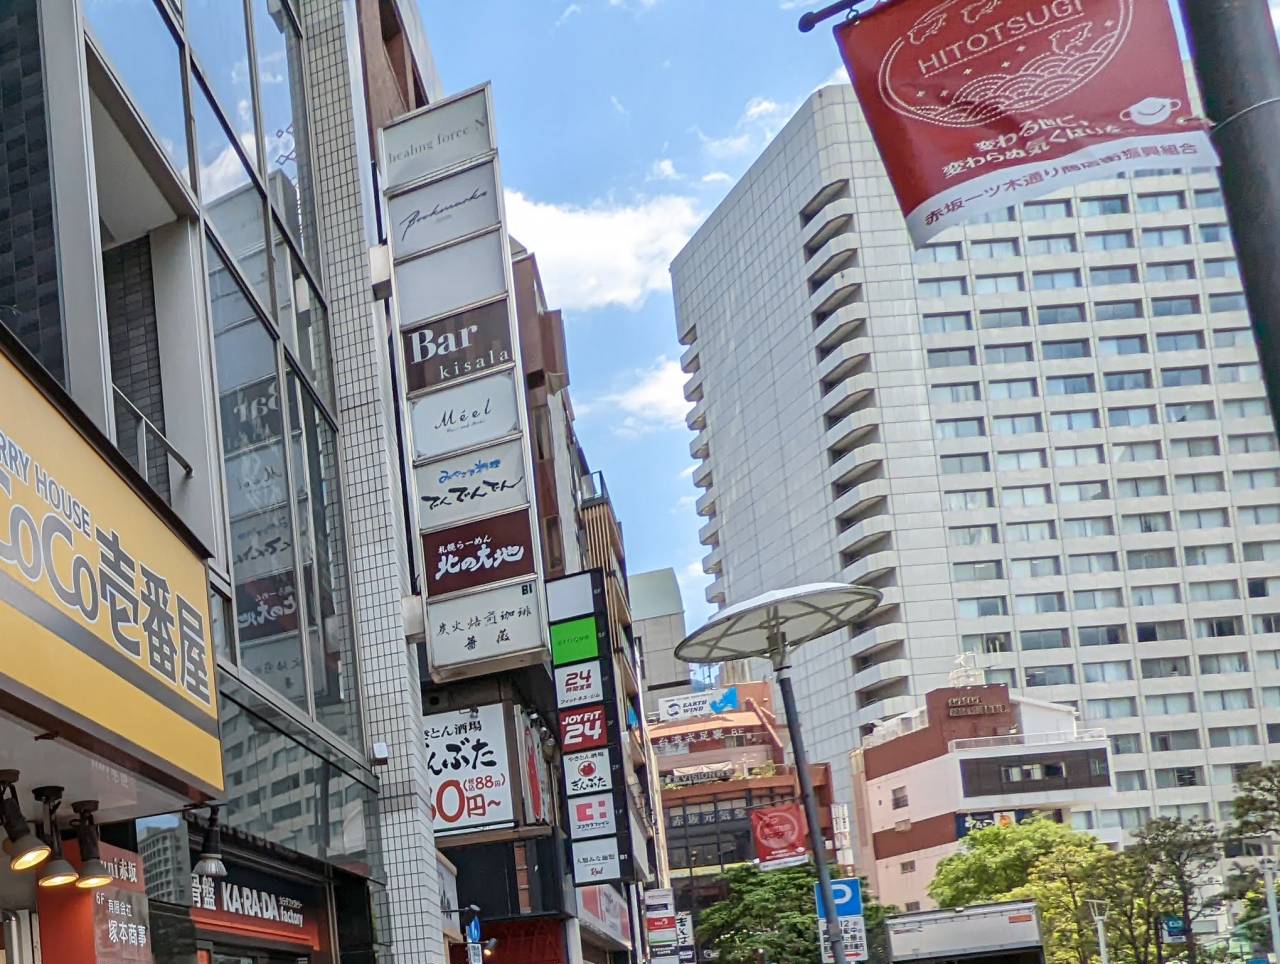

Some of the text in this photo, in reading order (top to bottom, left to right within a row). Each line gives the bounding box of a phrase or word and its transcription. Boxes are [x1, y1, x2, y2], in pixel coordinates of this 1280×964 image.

[388, 140, 433, 165] healing
[437, 126, 469, 145] force
[408, 324, 478, 364] Bar
[440, 350, 509, 379] kisala
[435, 398, 492, 430] Méel
[34, 464, 91, 539] HOUSE
[438, 535, 491, 554] 札幌らーめん
[435, 544, 524, 580] 北の大地
[565, 669, 592, 687] 24
[683, 706, 704, 714] WIND
[564, 719, 602, 745] 24
[425, 737, 497, 775] んぶた
[571, 776, 607, 791] ぎんぶた
[96, 892, 105, 905] 6F
[108, 899, 133, 917] 有限会社
[281, 906, 303, 927] factory
[108, 920, 147, 947] 塚本商事
